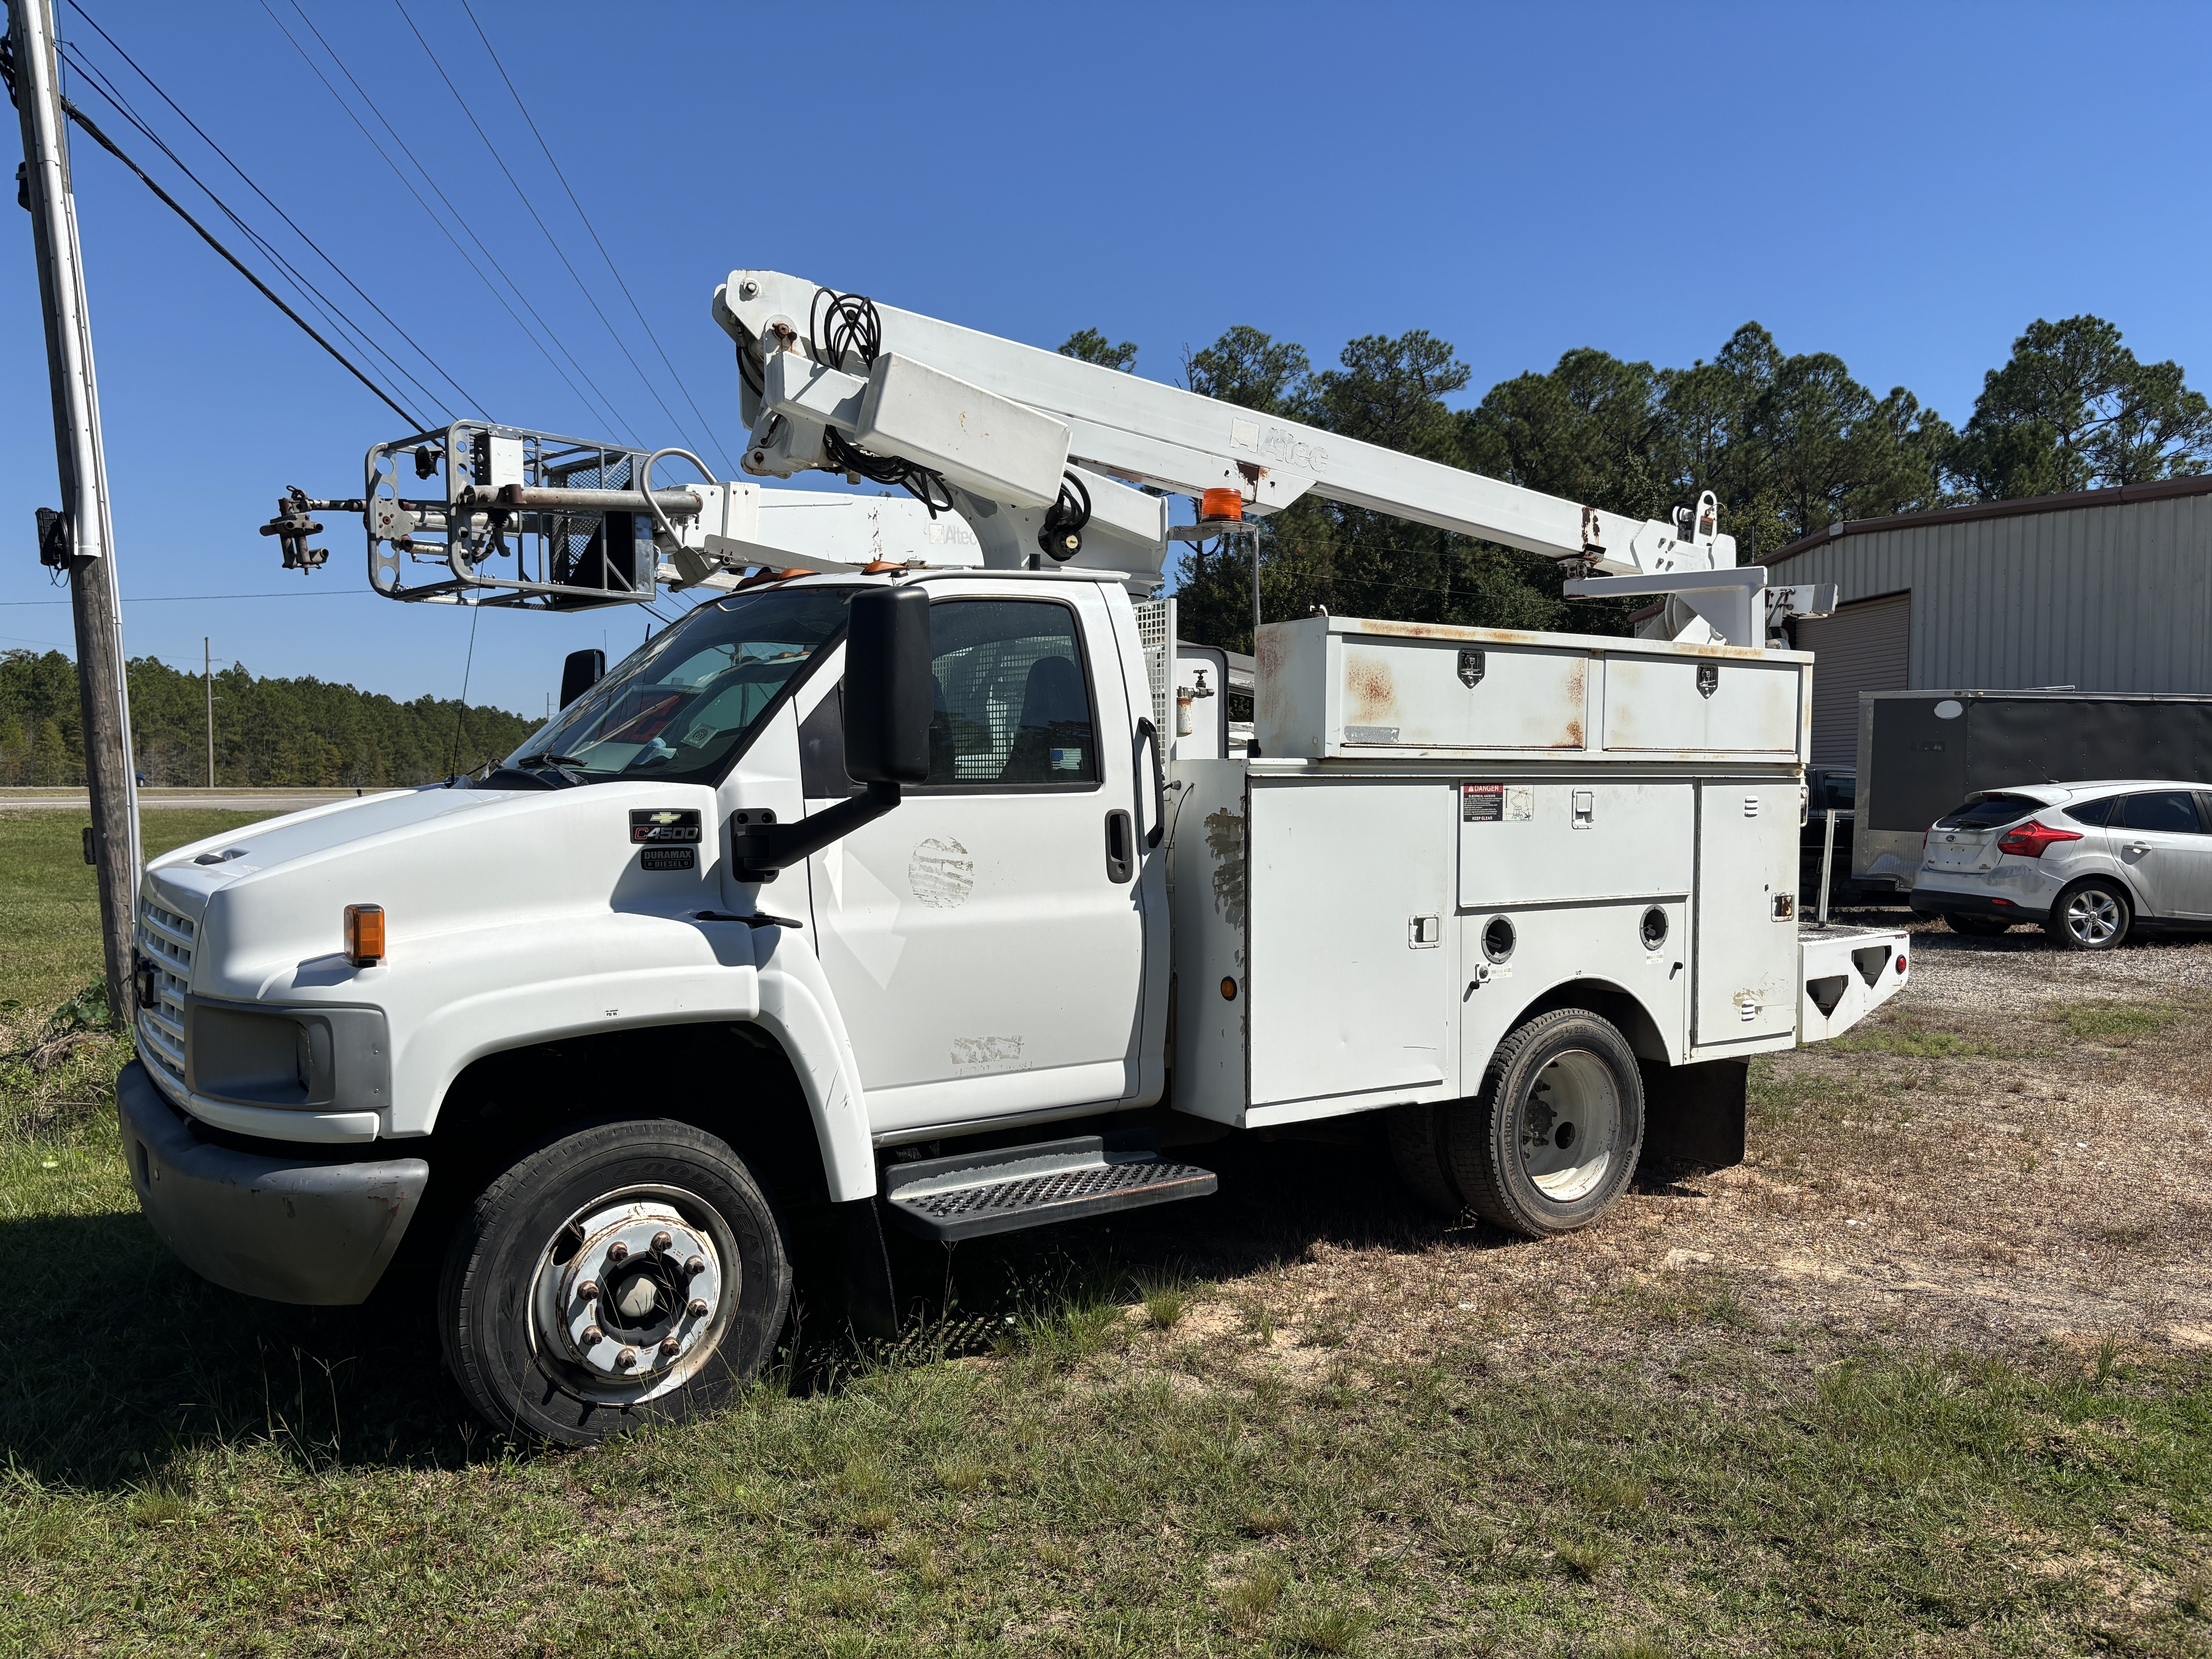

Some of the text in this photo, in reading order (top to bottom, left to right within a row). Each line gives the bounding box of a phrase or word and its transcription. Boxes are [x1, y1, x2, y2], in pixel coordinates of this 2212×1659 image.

[1258, 427, 1328, 474] Altec
[945, 525, 977, 546] Altec
[635, 827, 698, 840] C4500
[644, 850, 692, 859] DURAMAX
[613, 1162, 763, 1284] GOODYEAR
